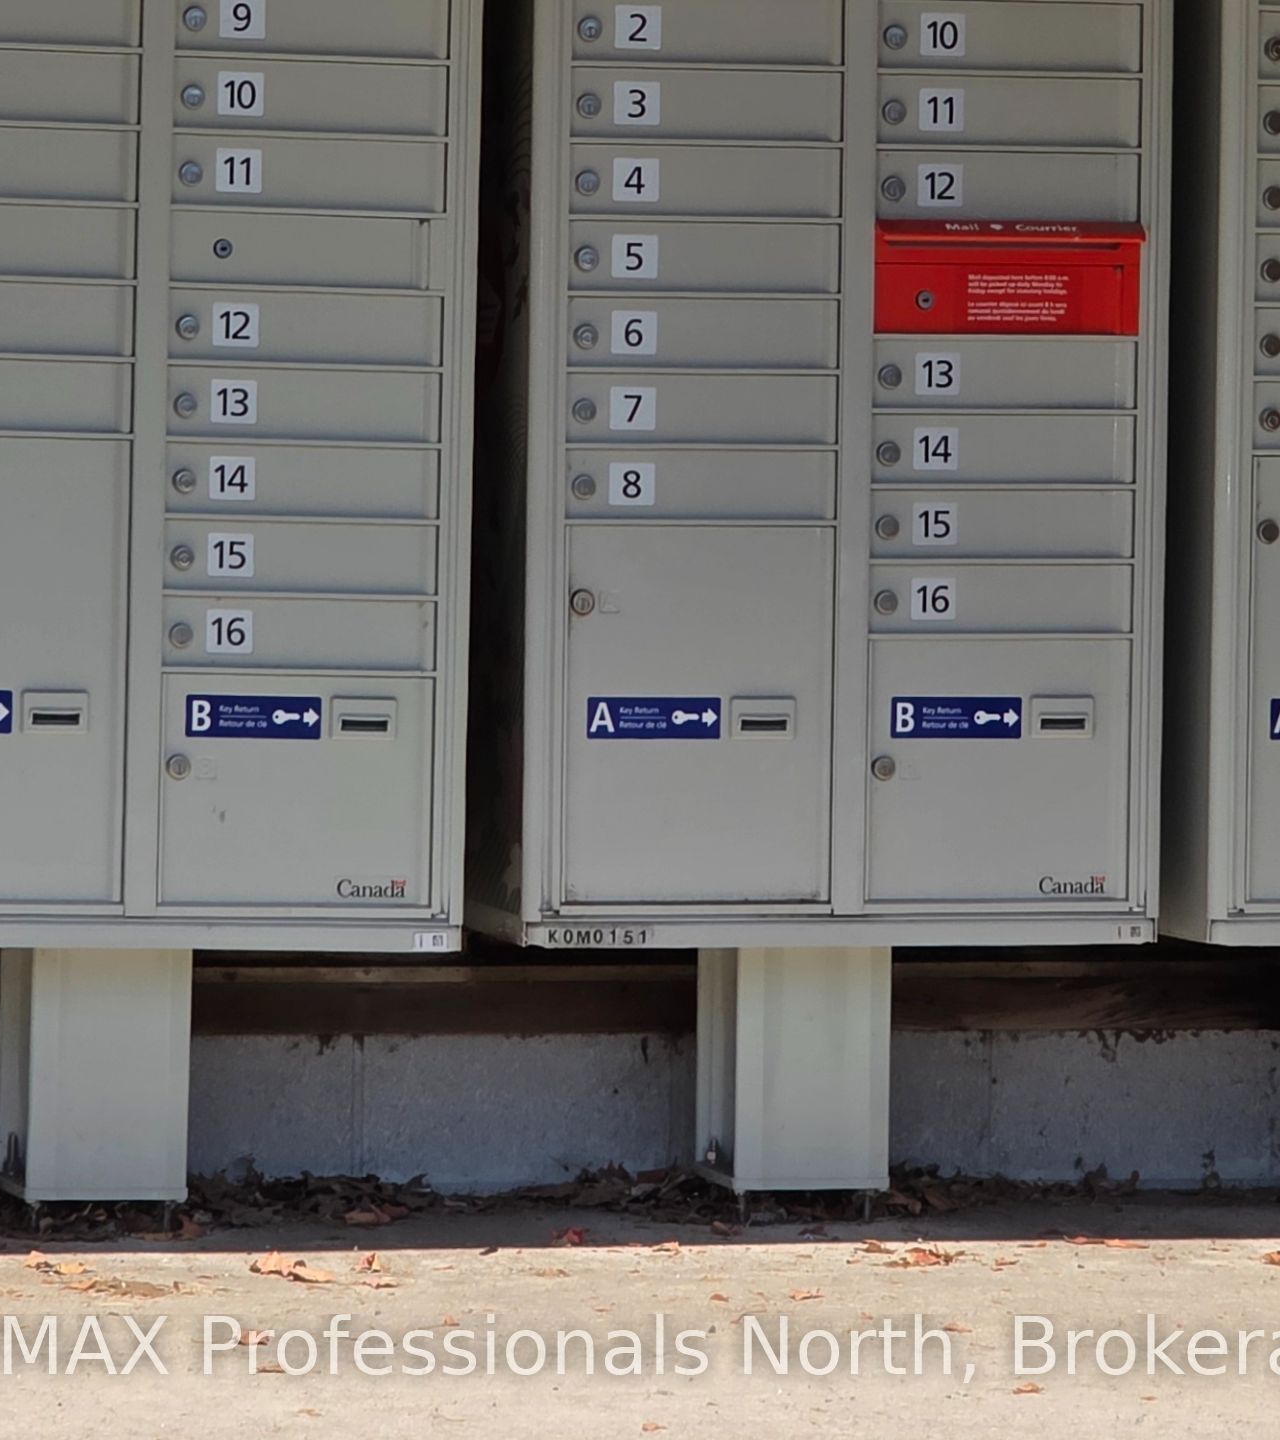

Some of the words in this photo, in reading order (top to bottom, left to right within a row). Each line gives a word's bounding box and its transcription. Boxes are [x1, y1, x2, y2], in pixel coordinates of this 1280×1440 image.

[232, 2, 252, 32] 9
[628, 13, 648, 42] 2
[927, 20, 959, 50] 10
[224, 79, 257, 110] 10
[627, 89, 647, 119] 3
[927, 96, 954, 125] 11
[223, 156, 251, 186] 11
[624, 166, 646, 195] 4
[924, 171, 956, 200] 12
[944, 223, 980, 232] Mail
[625, 242, 643, 271] 5
[219, 310, 251, 340] 12
[624, 318, 643, 347] 6
[922, 359, 953, 389] 13
[216, 387, 249, 417] 13
[623, 394, 643, 423] 7
[919, 435, 952, 464] 14
[214, 464, 249, 494] 14
[622, 470, 642, 499] 8
[918, 510, 951, 539] 15
[213, 540, 246, 570] 15
[916, 585, 950, 614] 16
[211, 617, 246, 647] 16
[191, 699, 212, 732] B
[589, 701, 616, 733] A
[895, 702, 915, 733] B
[336, 878, 405, 898] Canada
[1038, 875, 1105, 895] Canada
